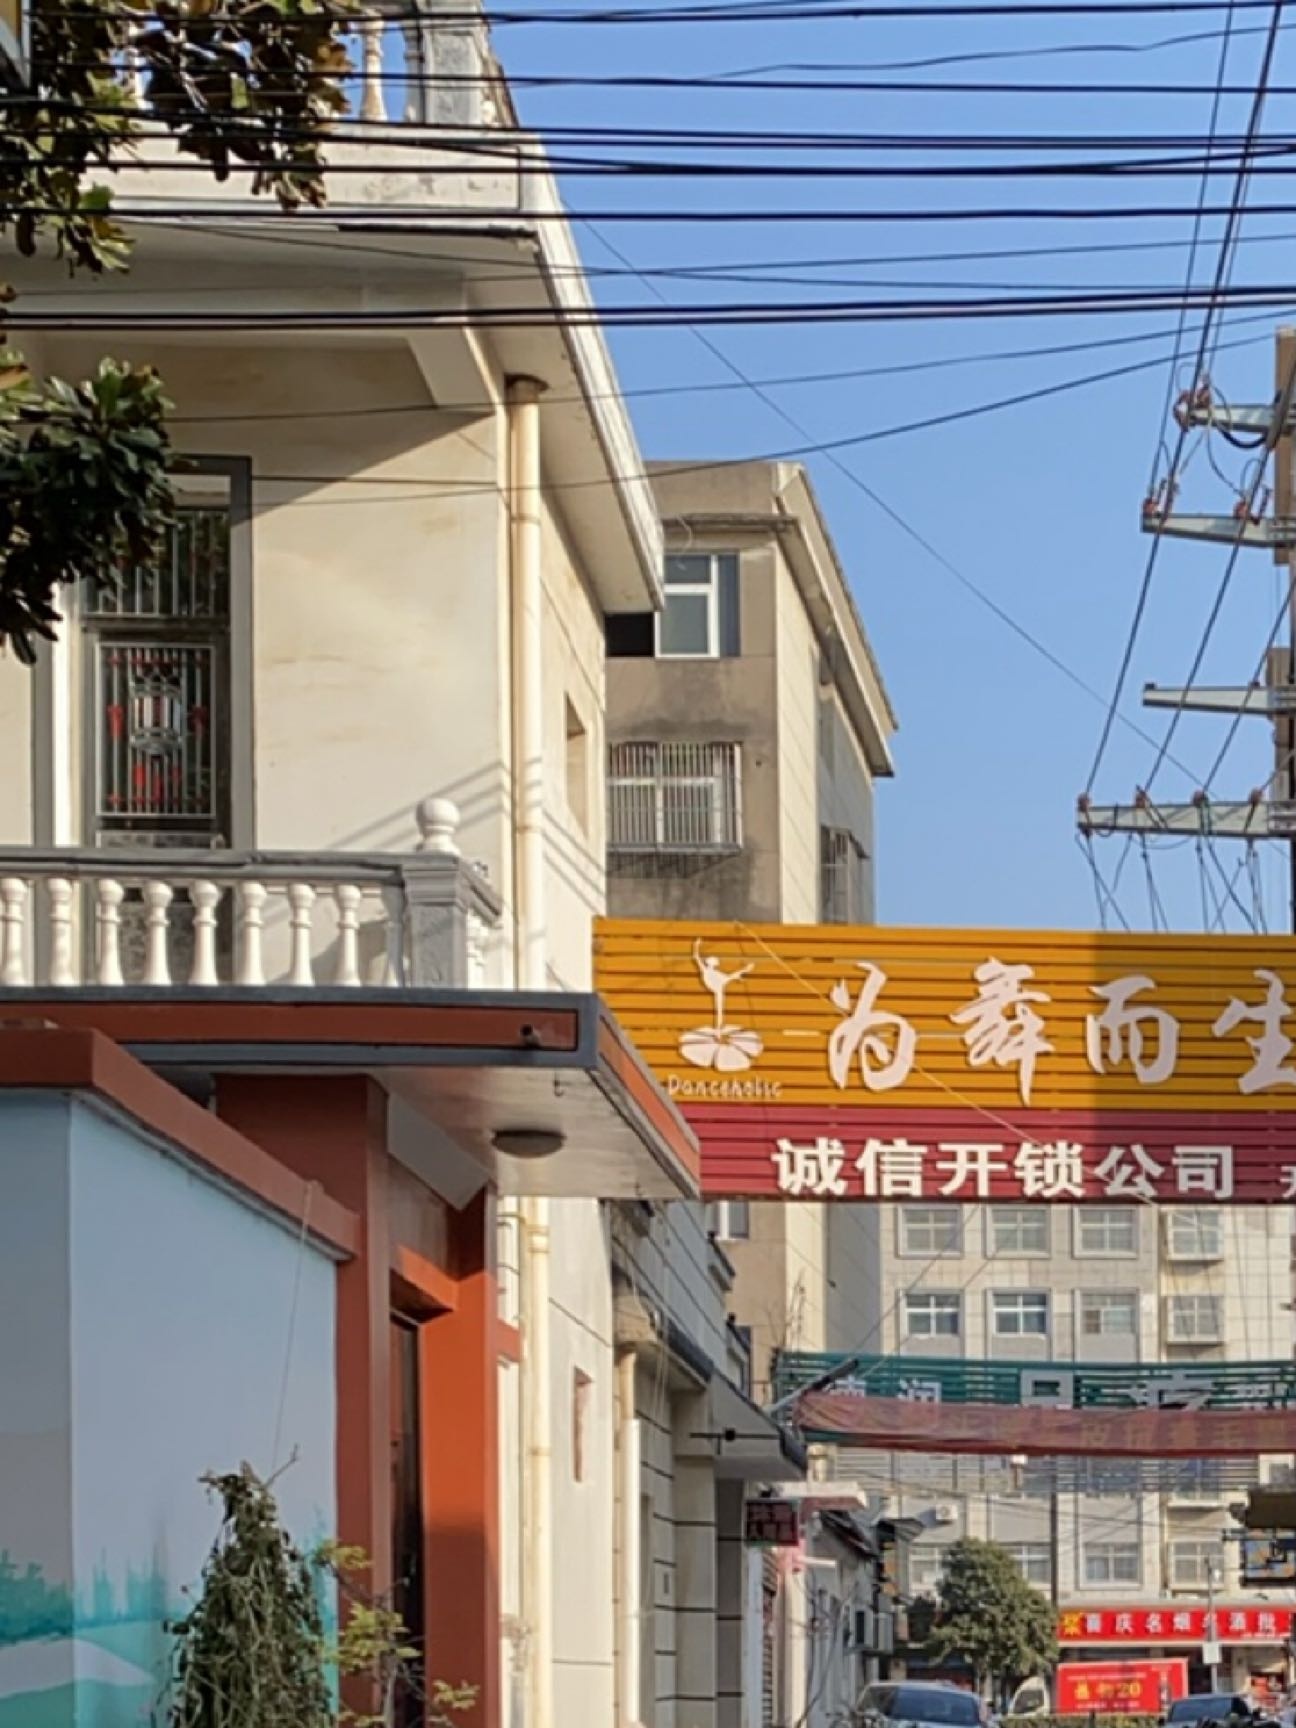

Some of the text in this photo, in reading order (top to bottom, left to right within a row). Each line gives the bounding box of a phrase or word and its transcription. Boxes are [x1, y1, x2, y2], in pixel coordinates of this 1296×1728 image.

[772, 1138, 1234, 1198] 诚信开锁公司
